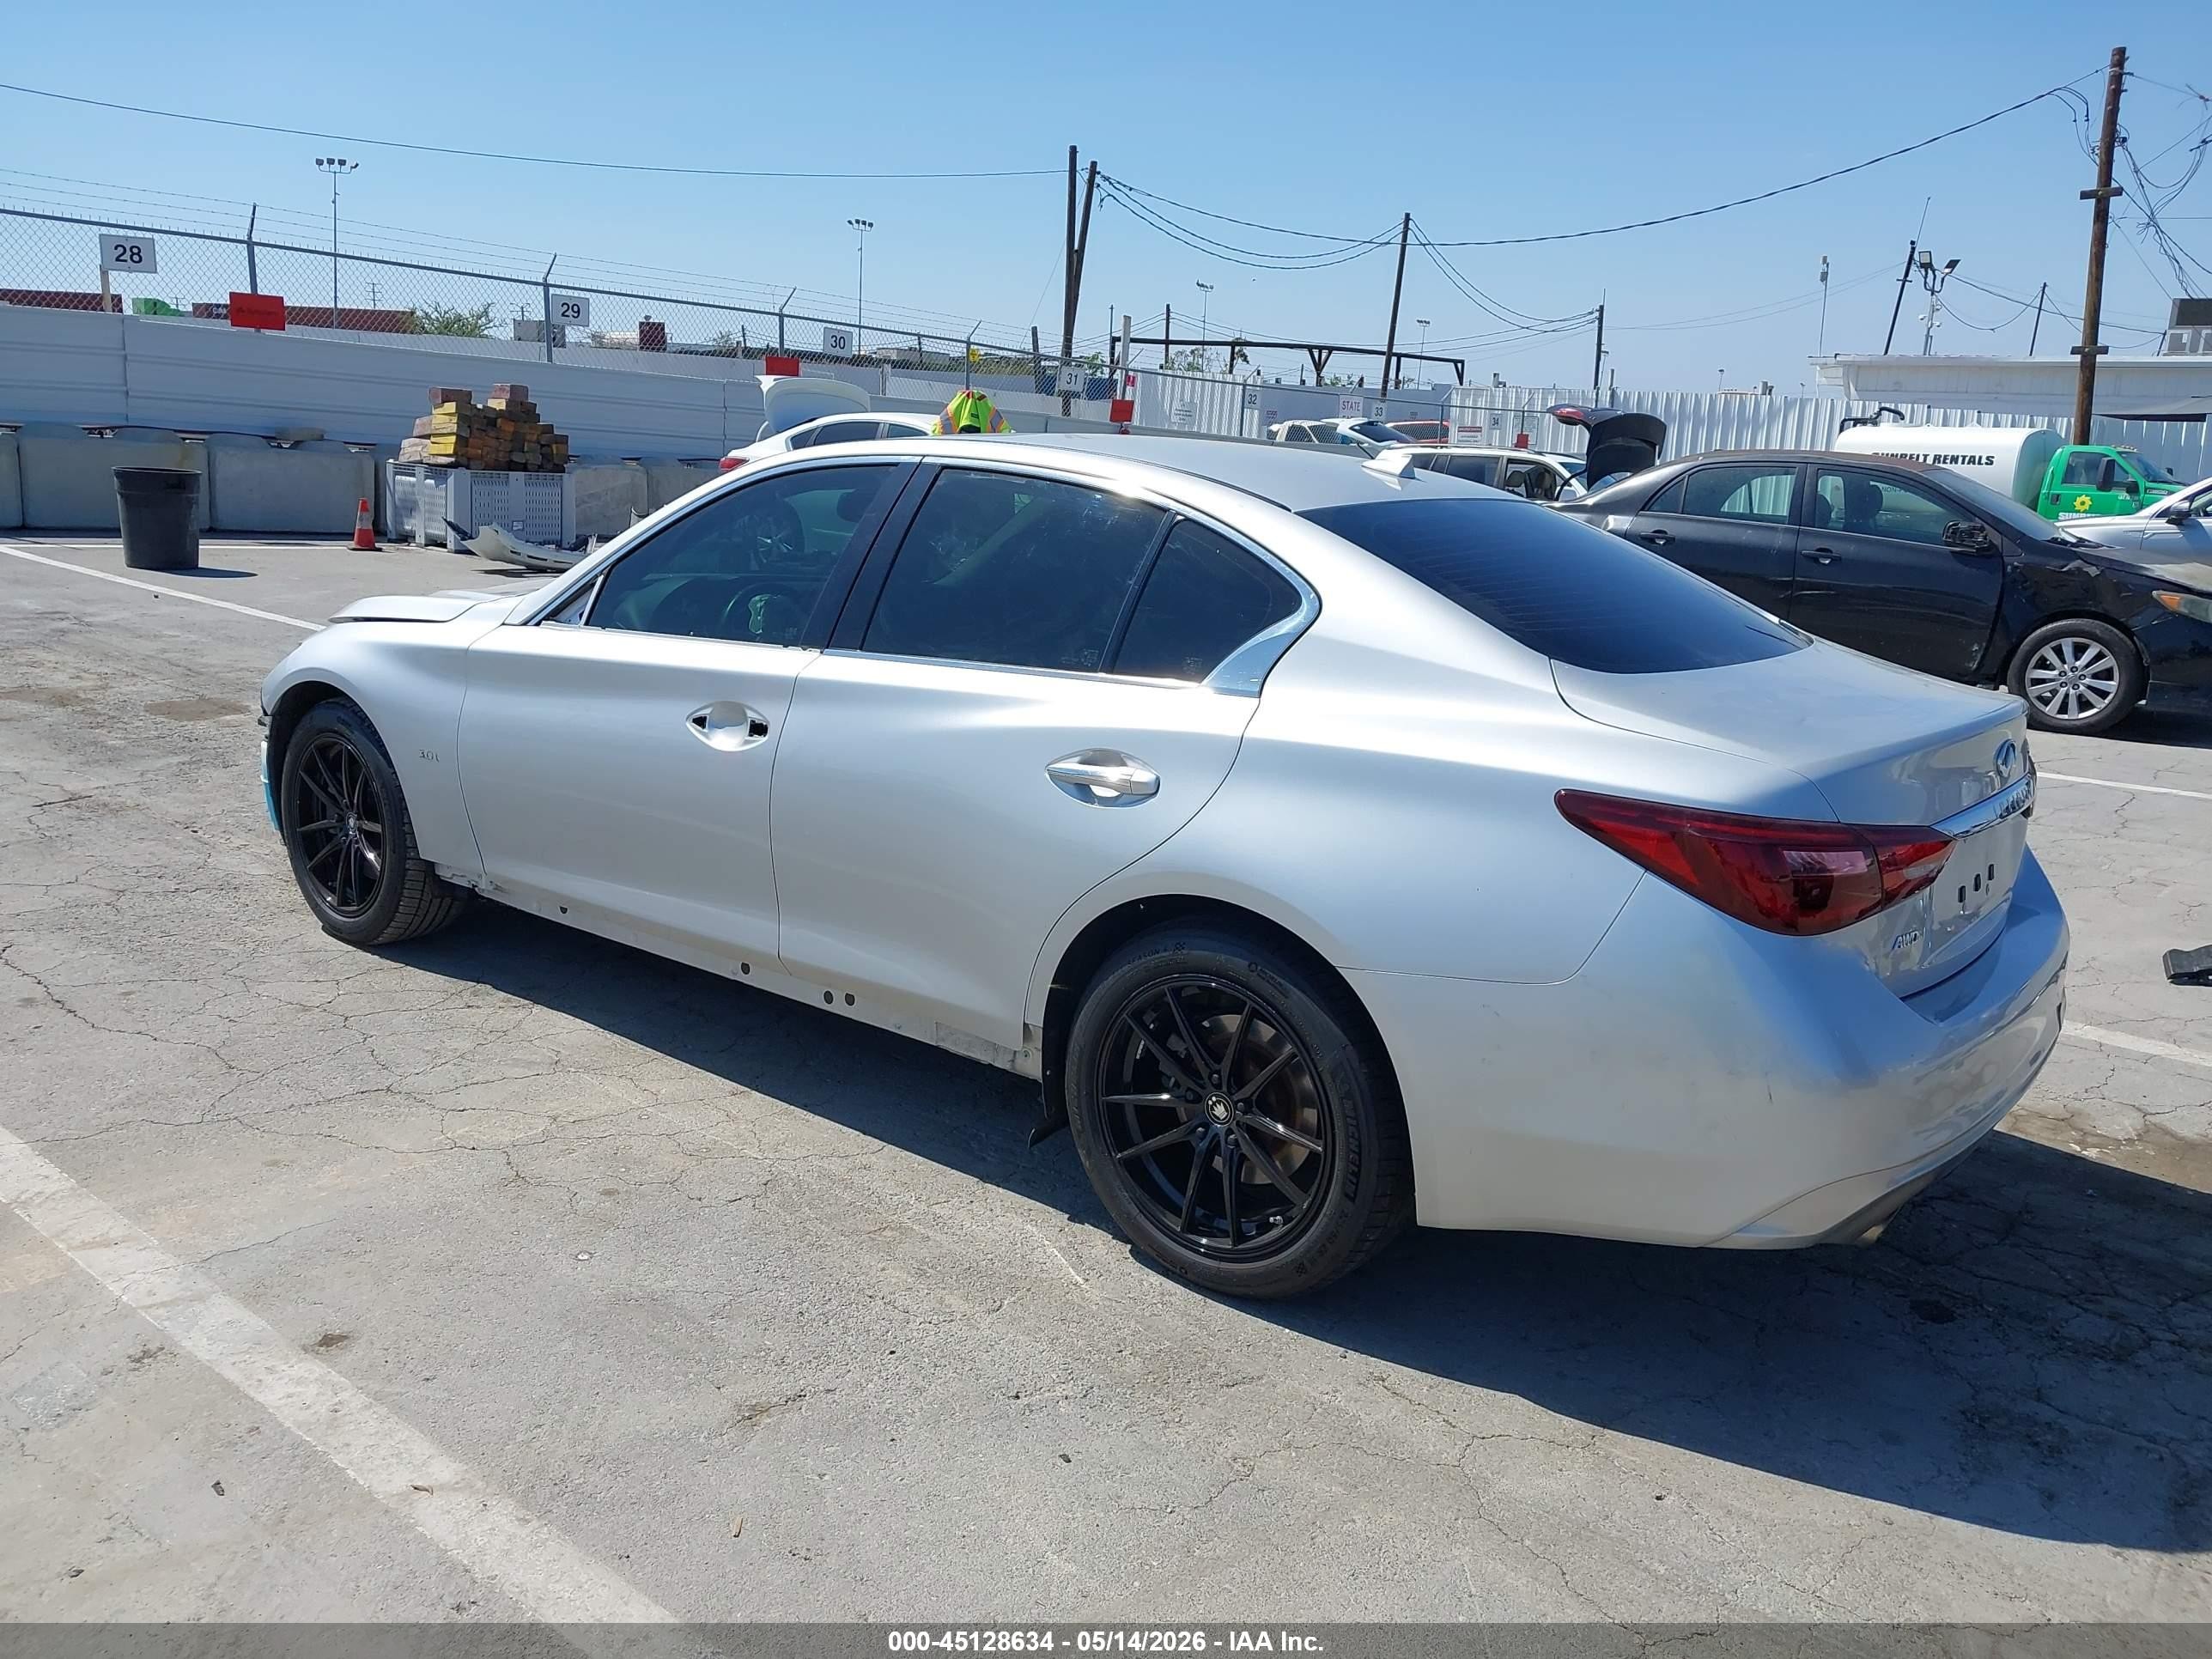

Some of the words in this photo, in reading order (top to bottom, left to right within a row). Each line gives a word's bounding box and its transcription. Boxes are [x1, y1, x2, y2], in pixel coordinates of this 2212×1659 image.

[113, 244, 143, 264] 28
[561, 302, 580, 319] 29
[830, 335, 846, 349] 30
[1066, 373, 1079, 386] 31
[1248, 394, 1257, 405] 32
[1341, 400, 1361, 412] STATE
[1374, 406, 1383, 417] 33
[1492, 417, 1499, 427] 34
[1932, 453, 1996, 466] RENTALS
